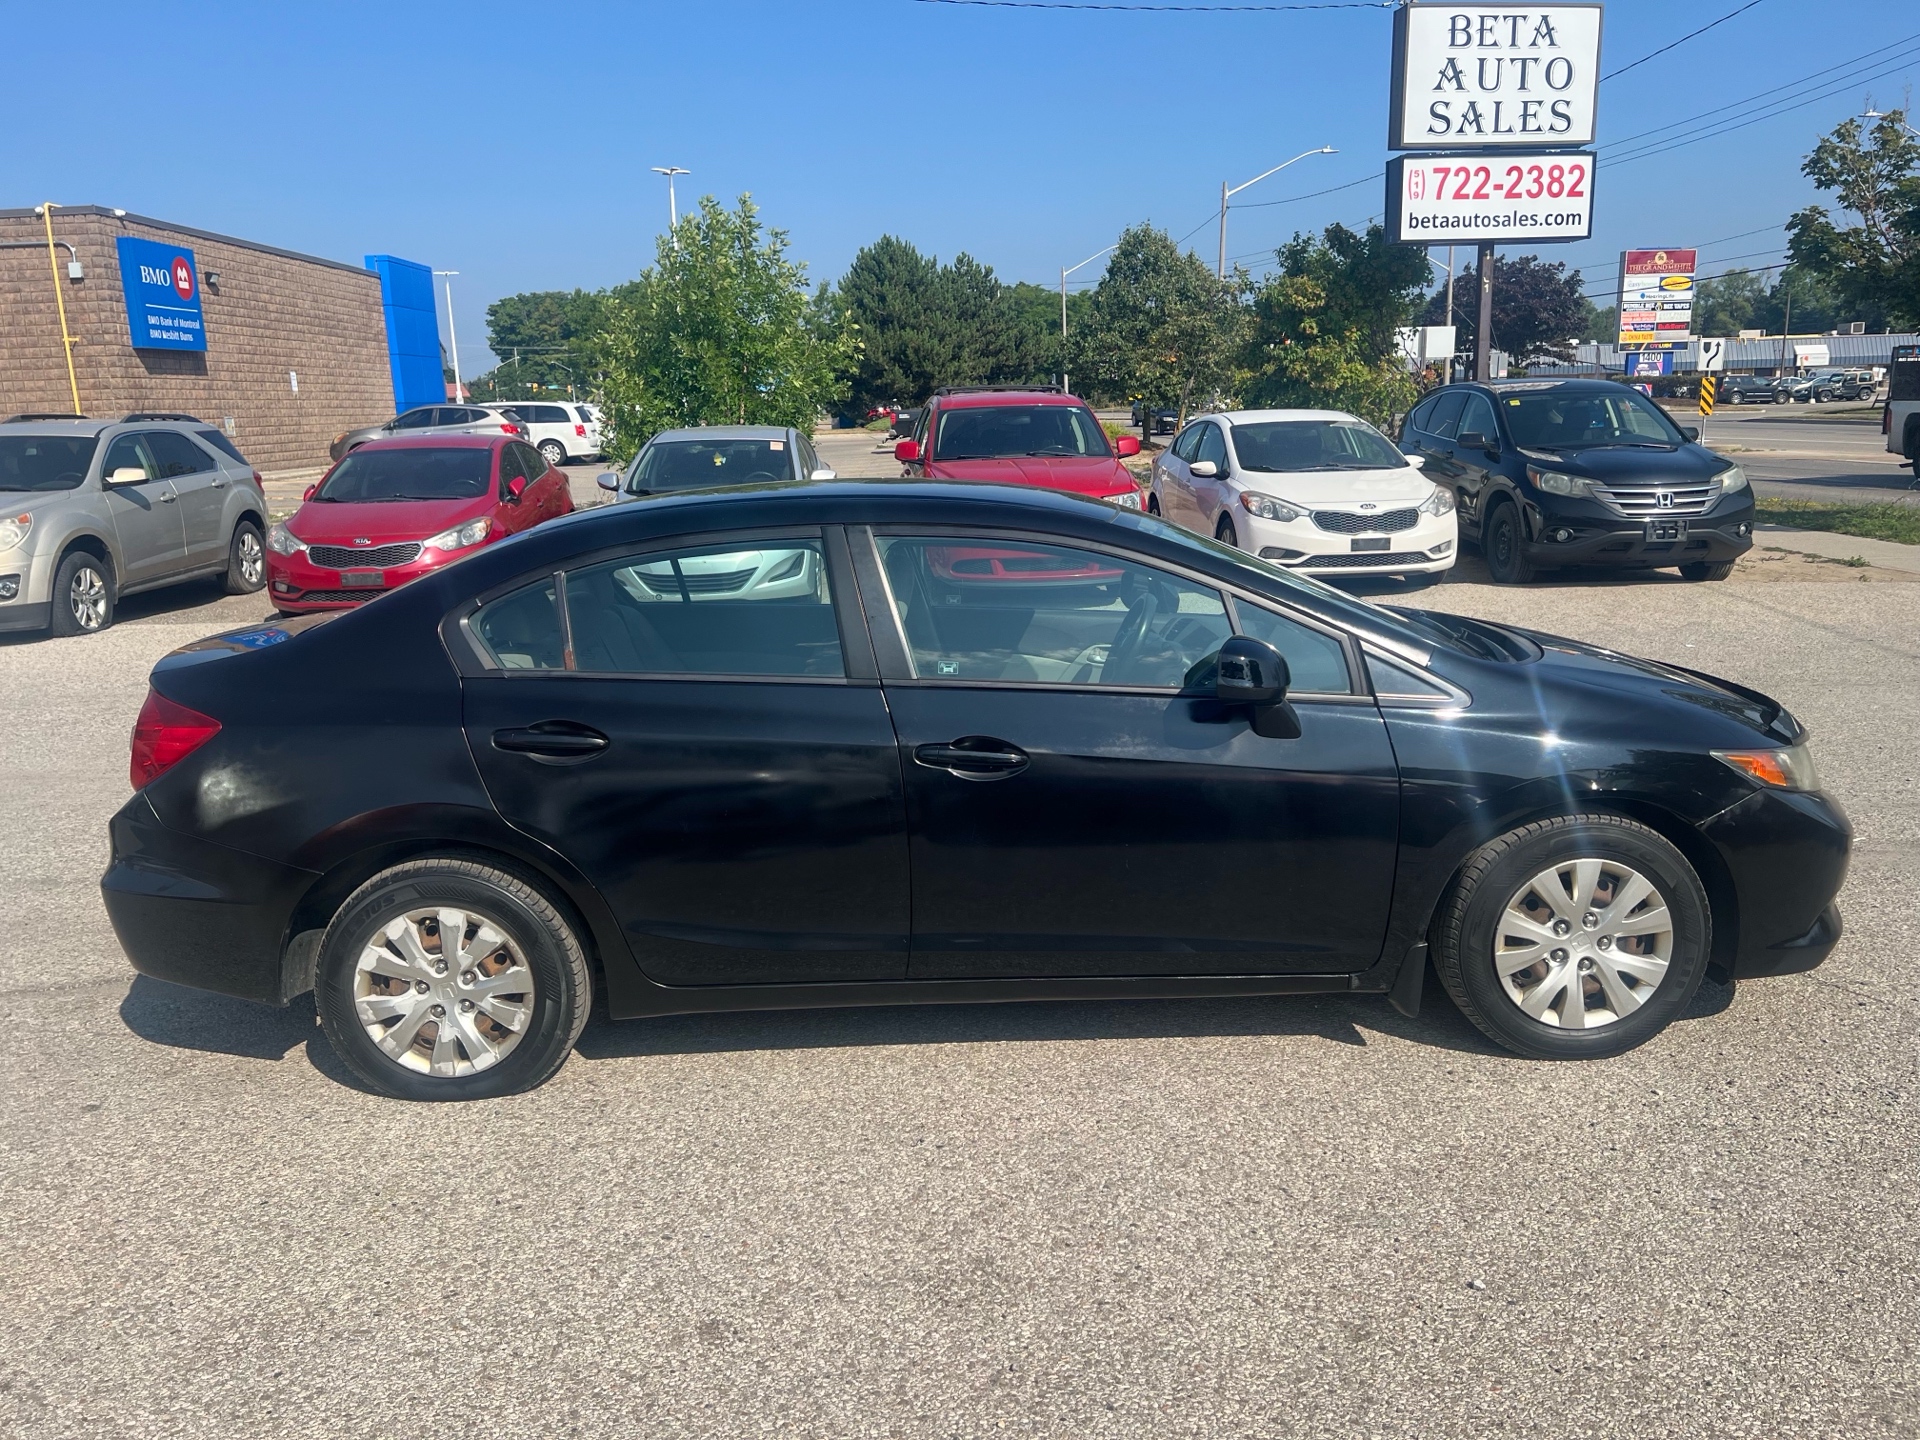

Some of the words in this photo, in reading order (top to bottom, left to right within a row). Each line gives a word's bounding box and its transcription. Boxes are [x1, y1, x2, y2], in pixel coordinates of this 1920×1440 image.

[1448, 14, 1560, 49] BETA
[1432, 57, 1575, 92] AUTO
[1427, 99, 1573, 135] SALES
[1432, 164, 1586, 201] 722-2382
[1408, 210, 1582, 230] betaautosales.com
[140, 266, 170, 287] BMO
[148, 315, 160, 325] BMO
[160, 317, 173, 327] Bank
[180, 319, 200, 329] Montreal
[150, 329, 161, 338] BMO
[1641, 353, 1662, 362] 1400
